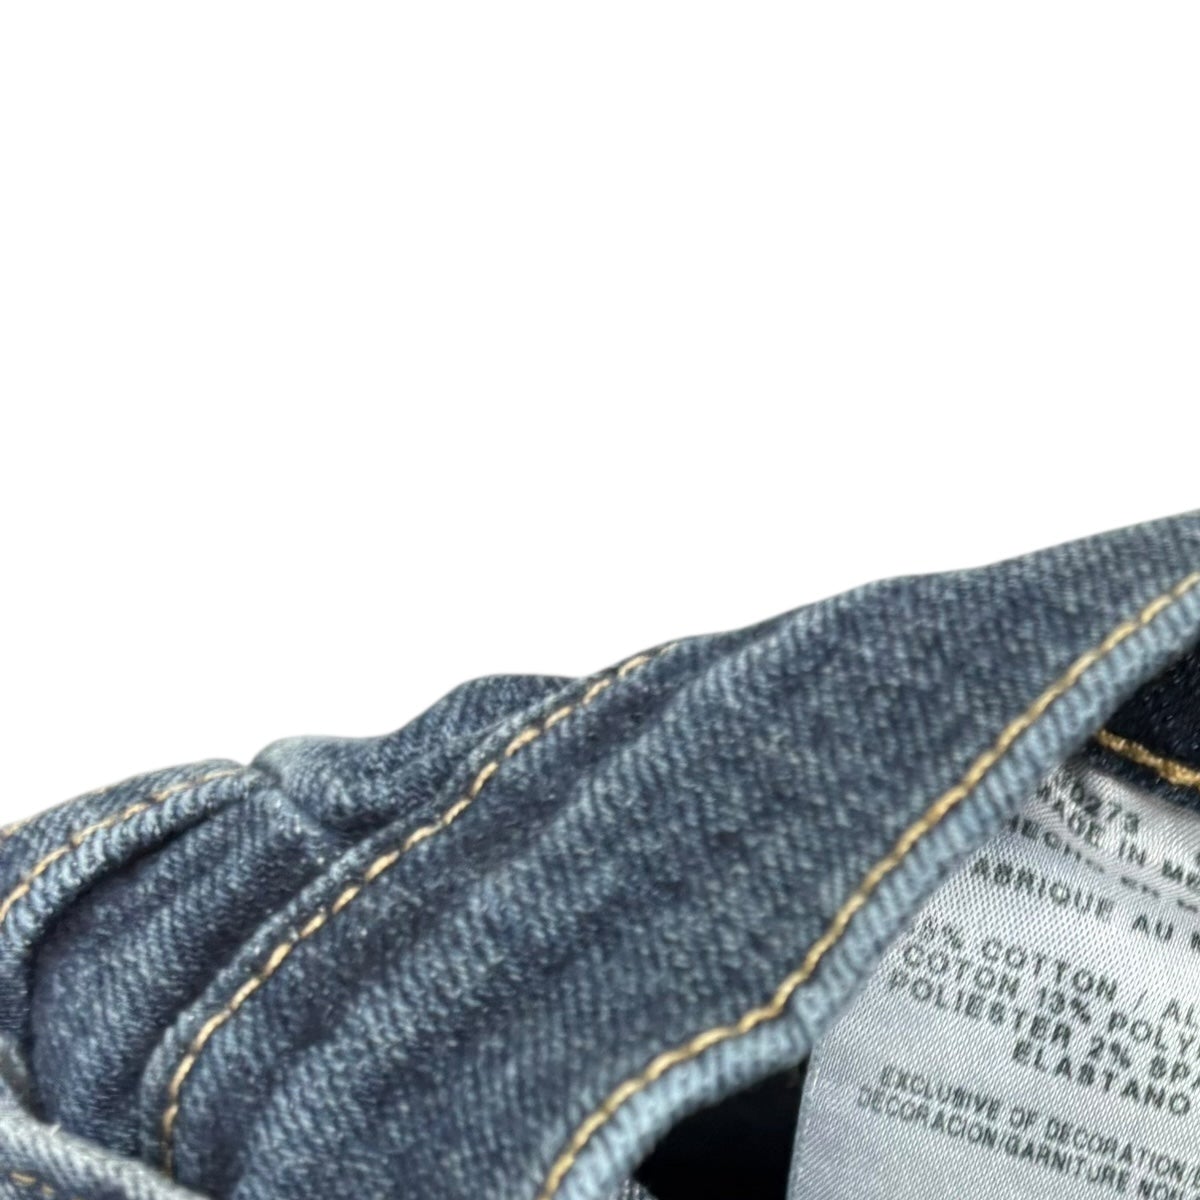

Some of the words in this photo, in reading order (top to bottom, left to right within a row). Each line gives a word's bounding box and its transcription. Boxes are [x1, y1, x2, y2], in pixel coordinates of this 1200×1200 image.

[1117, 838, 1147, 867] IN
[969, 854, 1114, 918] ABRIQUE
[1131, 911, 1174, 943] AU
[902, 943, 1020, 998] COTON
[1038, 984, 1092, 1026] 13%
[981, 937, 1118, 1003] COTTON
[888, 966, 1072, 1050] POLIESTER
[1086, 1034, 1132, 1071] 2%
[880, 1063, 1001, 1123] EXCLUSIVE
[1008, 1105, 1038, 1133] OF
[1011, 1039, 1190, 1117] ELASTANO
[857, 1083, 1131, 1195] DECORACION/GARNITURE
